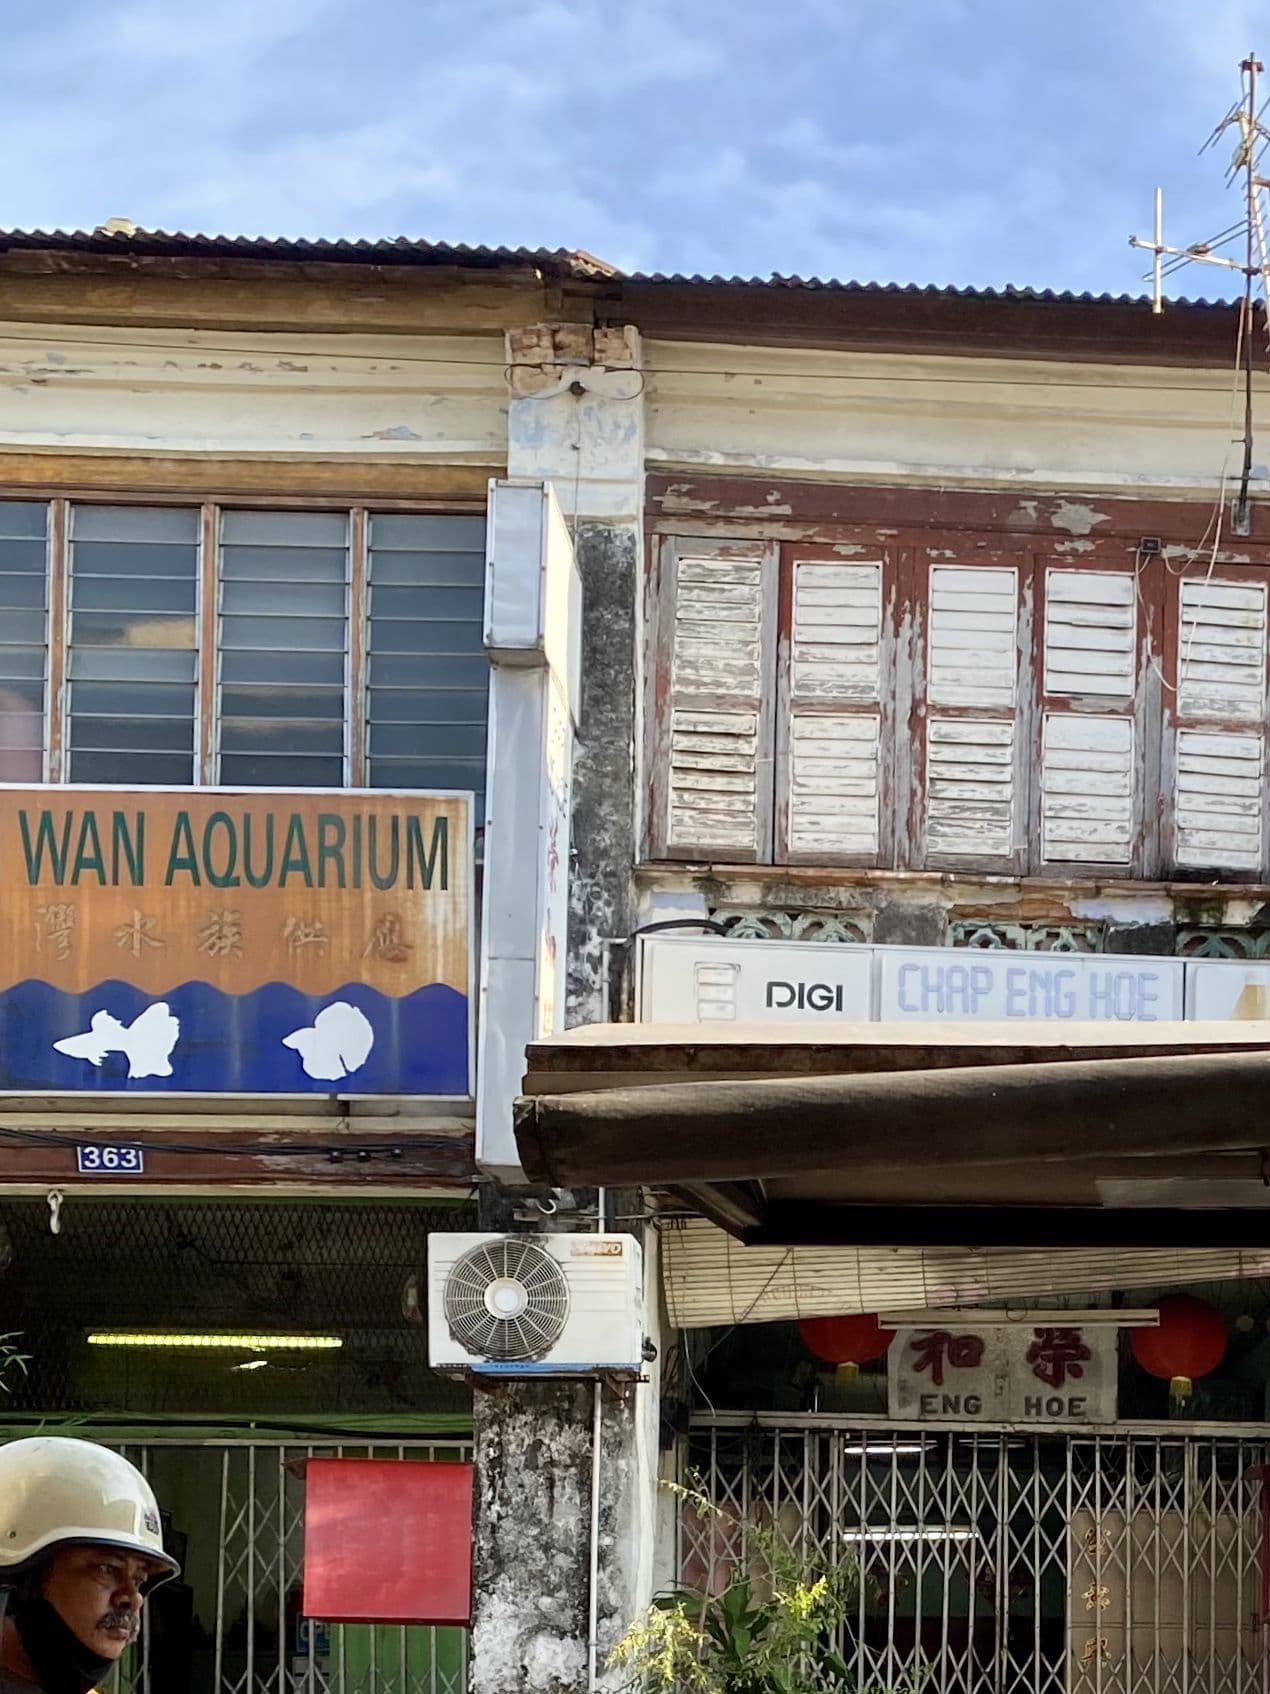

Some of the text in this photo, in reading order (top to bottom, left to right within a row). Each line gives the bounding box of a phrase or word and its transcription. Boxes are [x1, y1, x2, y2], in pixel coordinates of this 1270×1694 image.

[19, 810, 449, 891] WAN AQUARIUM
[766, 981, 843, 1012] DIGI
[897, 963, 1159, 1021] CHAP ENG HOE
[83, 1147, 138, 1169] 363
[920, 1394, 1087, 1417] ENG HOE
